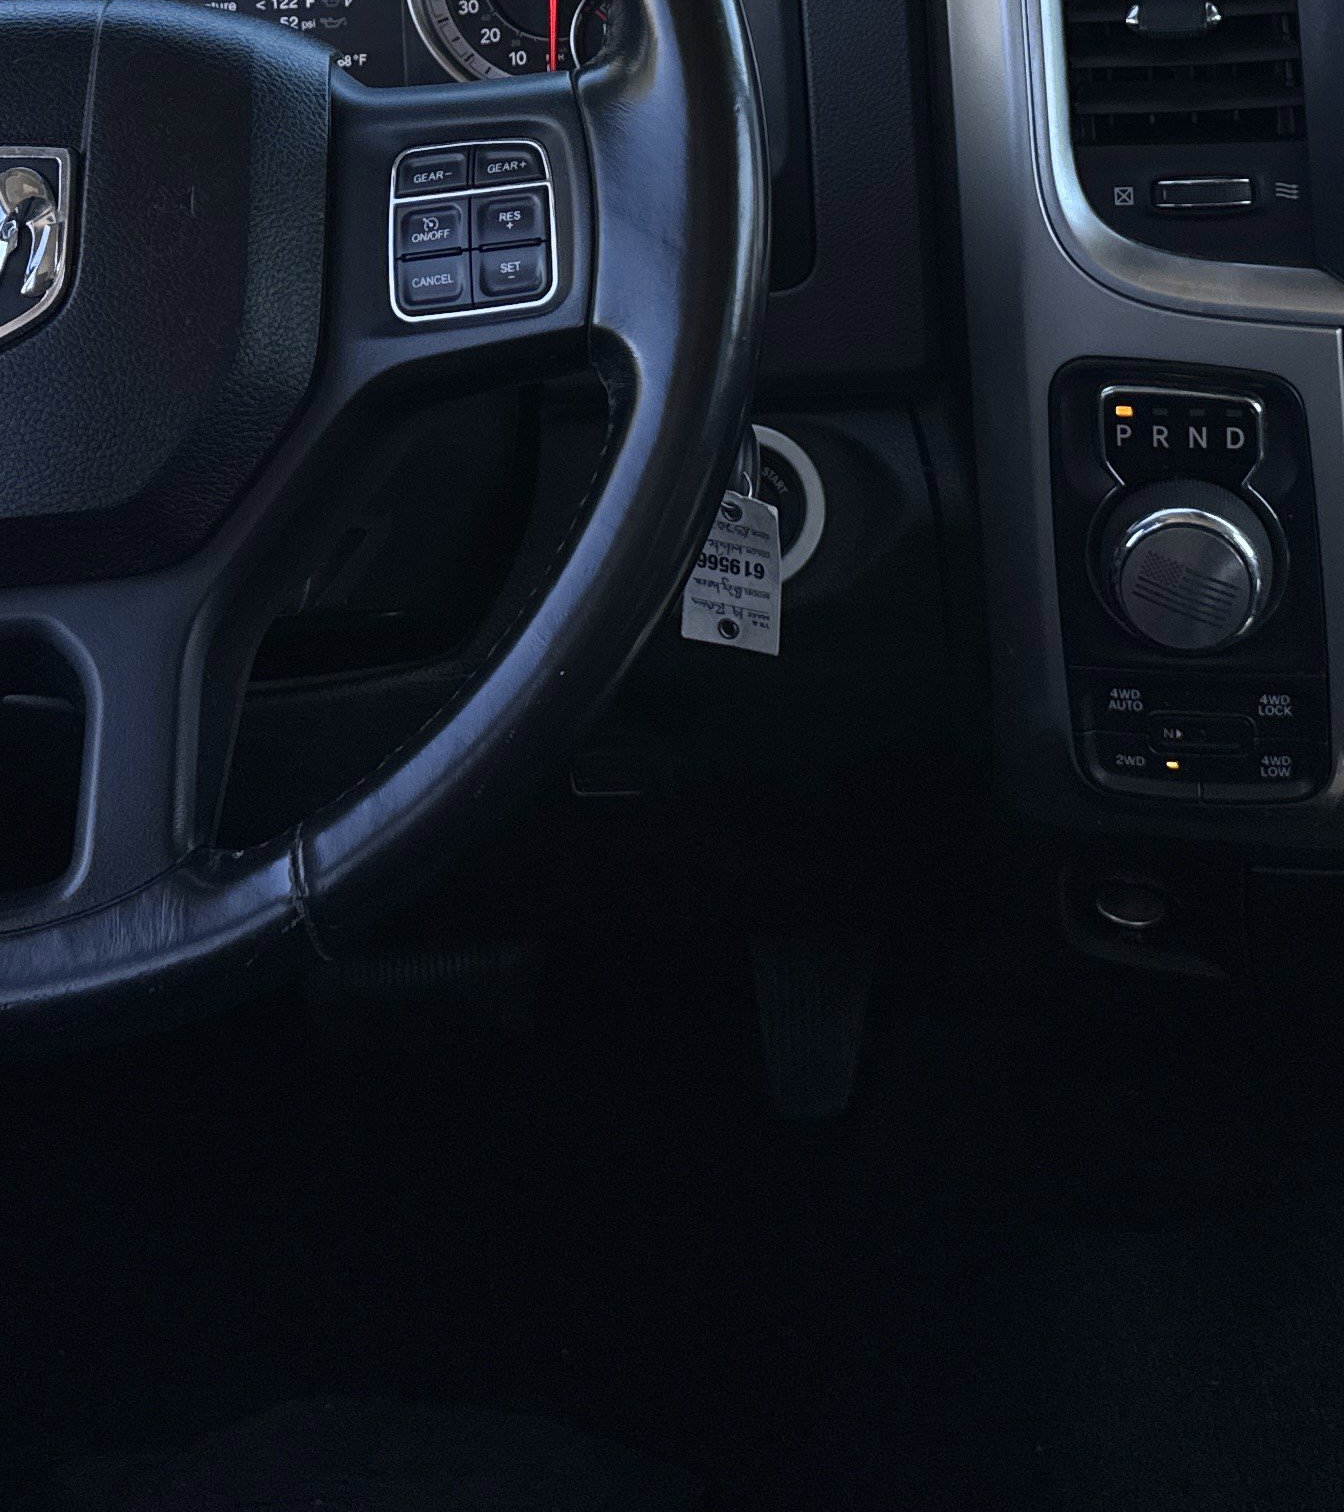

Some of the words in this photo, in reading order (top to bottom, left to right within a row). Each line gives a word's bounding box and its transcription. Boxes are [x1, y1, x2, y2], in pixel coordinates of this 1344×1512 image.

[458, 0, 479, 14] 30
[301, 19, 316, 30] psi
[480, 27, 501, 44] 20
[508, 51, 527, 65] 10
[499, 210, 521, 222] RES
[411, 229, 451, 243] ON/OFF
[500, 261, 521, 273] SET
[412, 274, 454, 288] CANCEL
[1116, 425, 1132, 447] P
[1153, 426, 1169, 448] R
[1188, 426, 1207, 449] N
[1226, 427, 1245, 449] D
[762, 467, 788, 494] START
[696, 552, 765, 579] 619566
[1110, 688, 1141, 700] 4WD
[1259, 694, 1291, 705] 4WD
[1108, 700, 1143, 711] AUTO
[1258, 705, 1293, 716] LOCK
[1115, 755, 1145, 766] 2WD
[1261, 755, 1291, 766] 4WD
[1261, 767, 1292, 777] LOW
